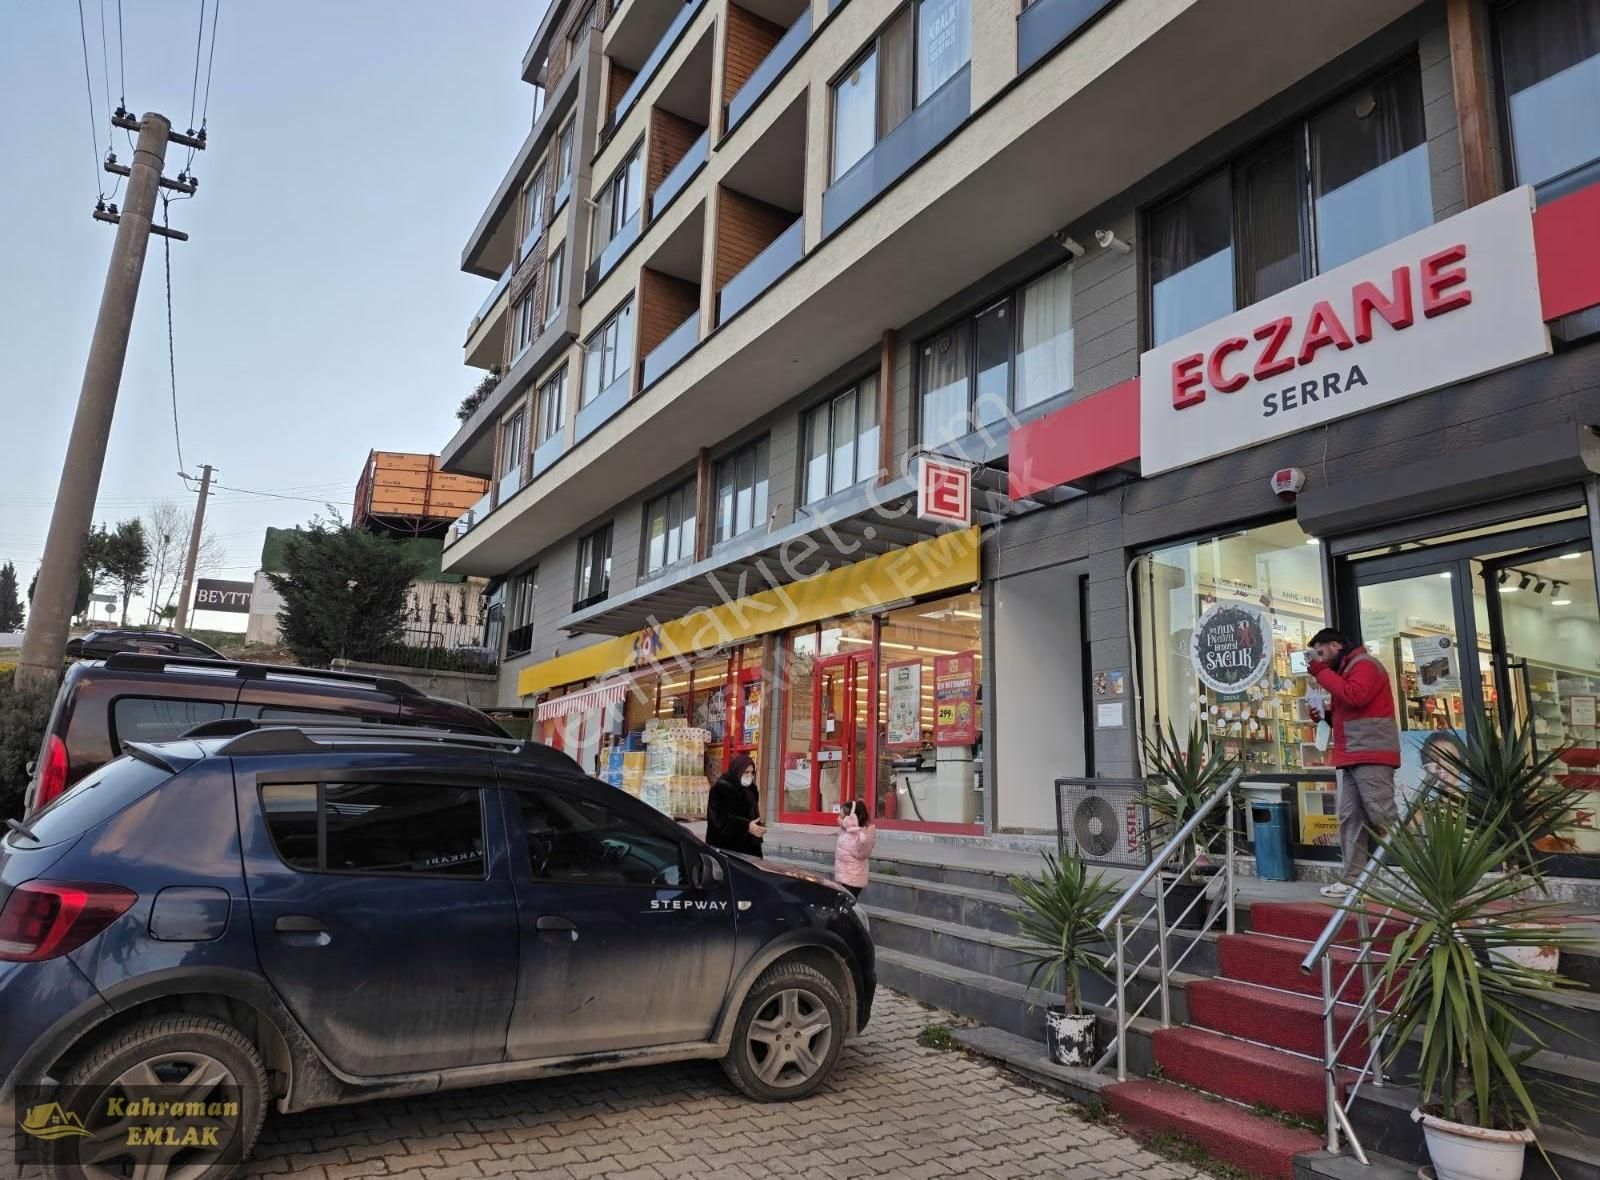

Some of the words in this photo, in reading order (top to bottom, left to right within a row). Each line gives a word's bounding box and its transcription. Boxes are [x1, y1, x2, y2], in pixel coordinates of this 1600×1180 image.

[1171, 243, 1472, 411] ECZANE
[1263, 364, 1368, 417] SERRA
[197, 589, 252, 605] BEYTT
[939, 709, 952, 719] 299
[650, 899, 728, 910] STEPWAY
